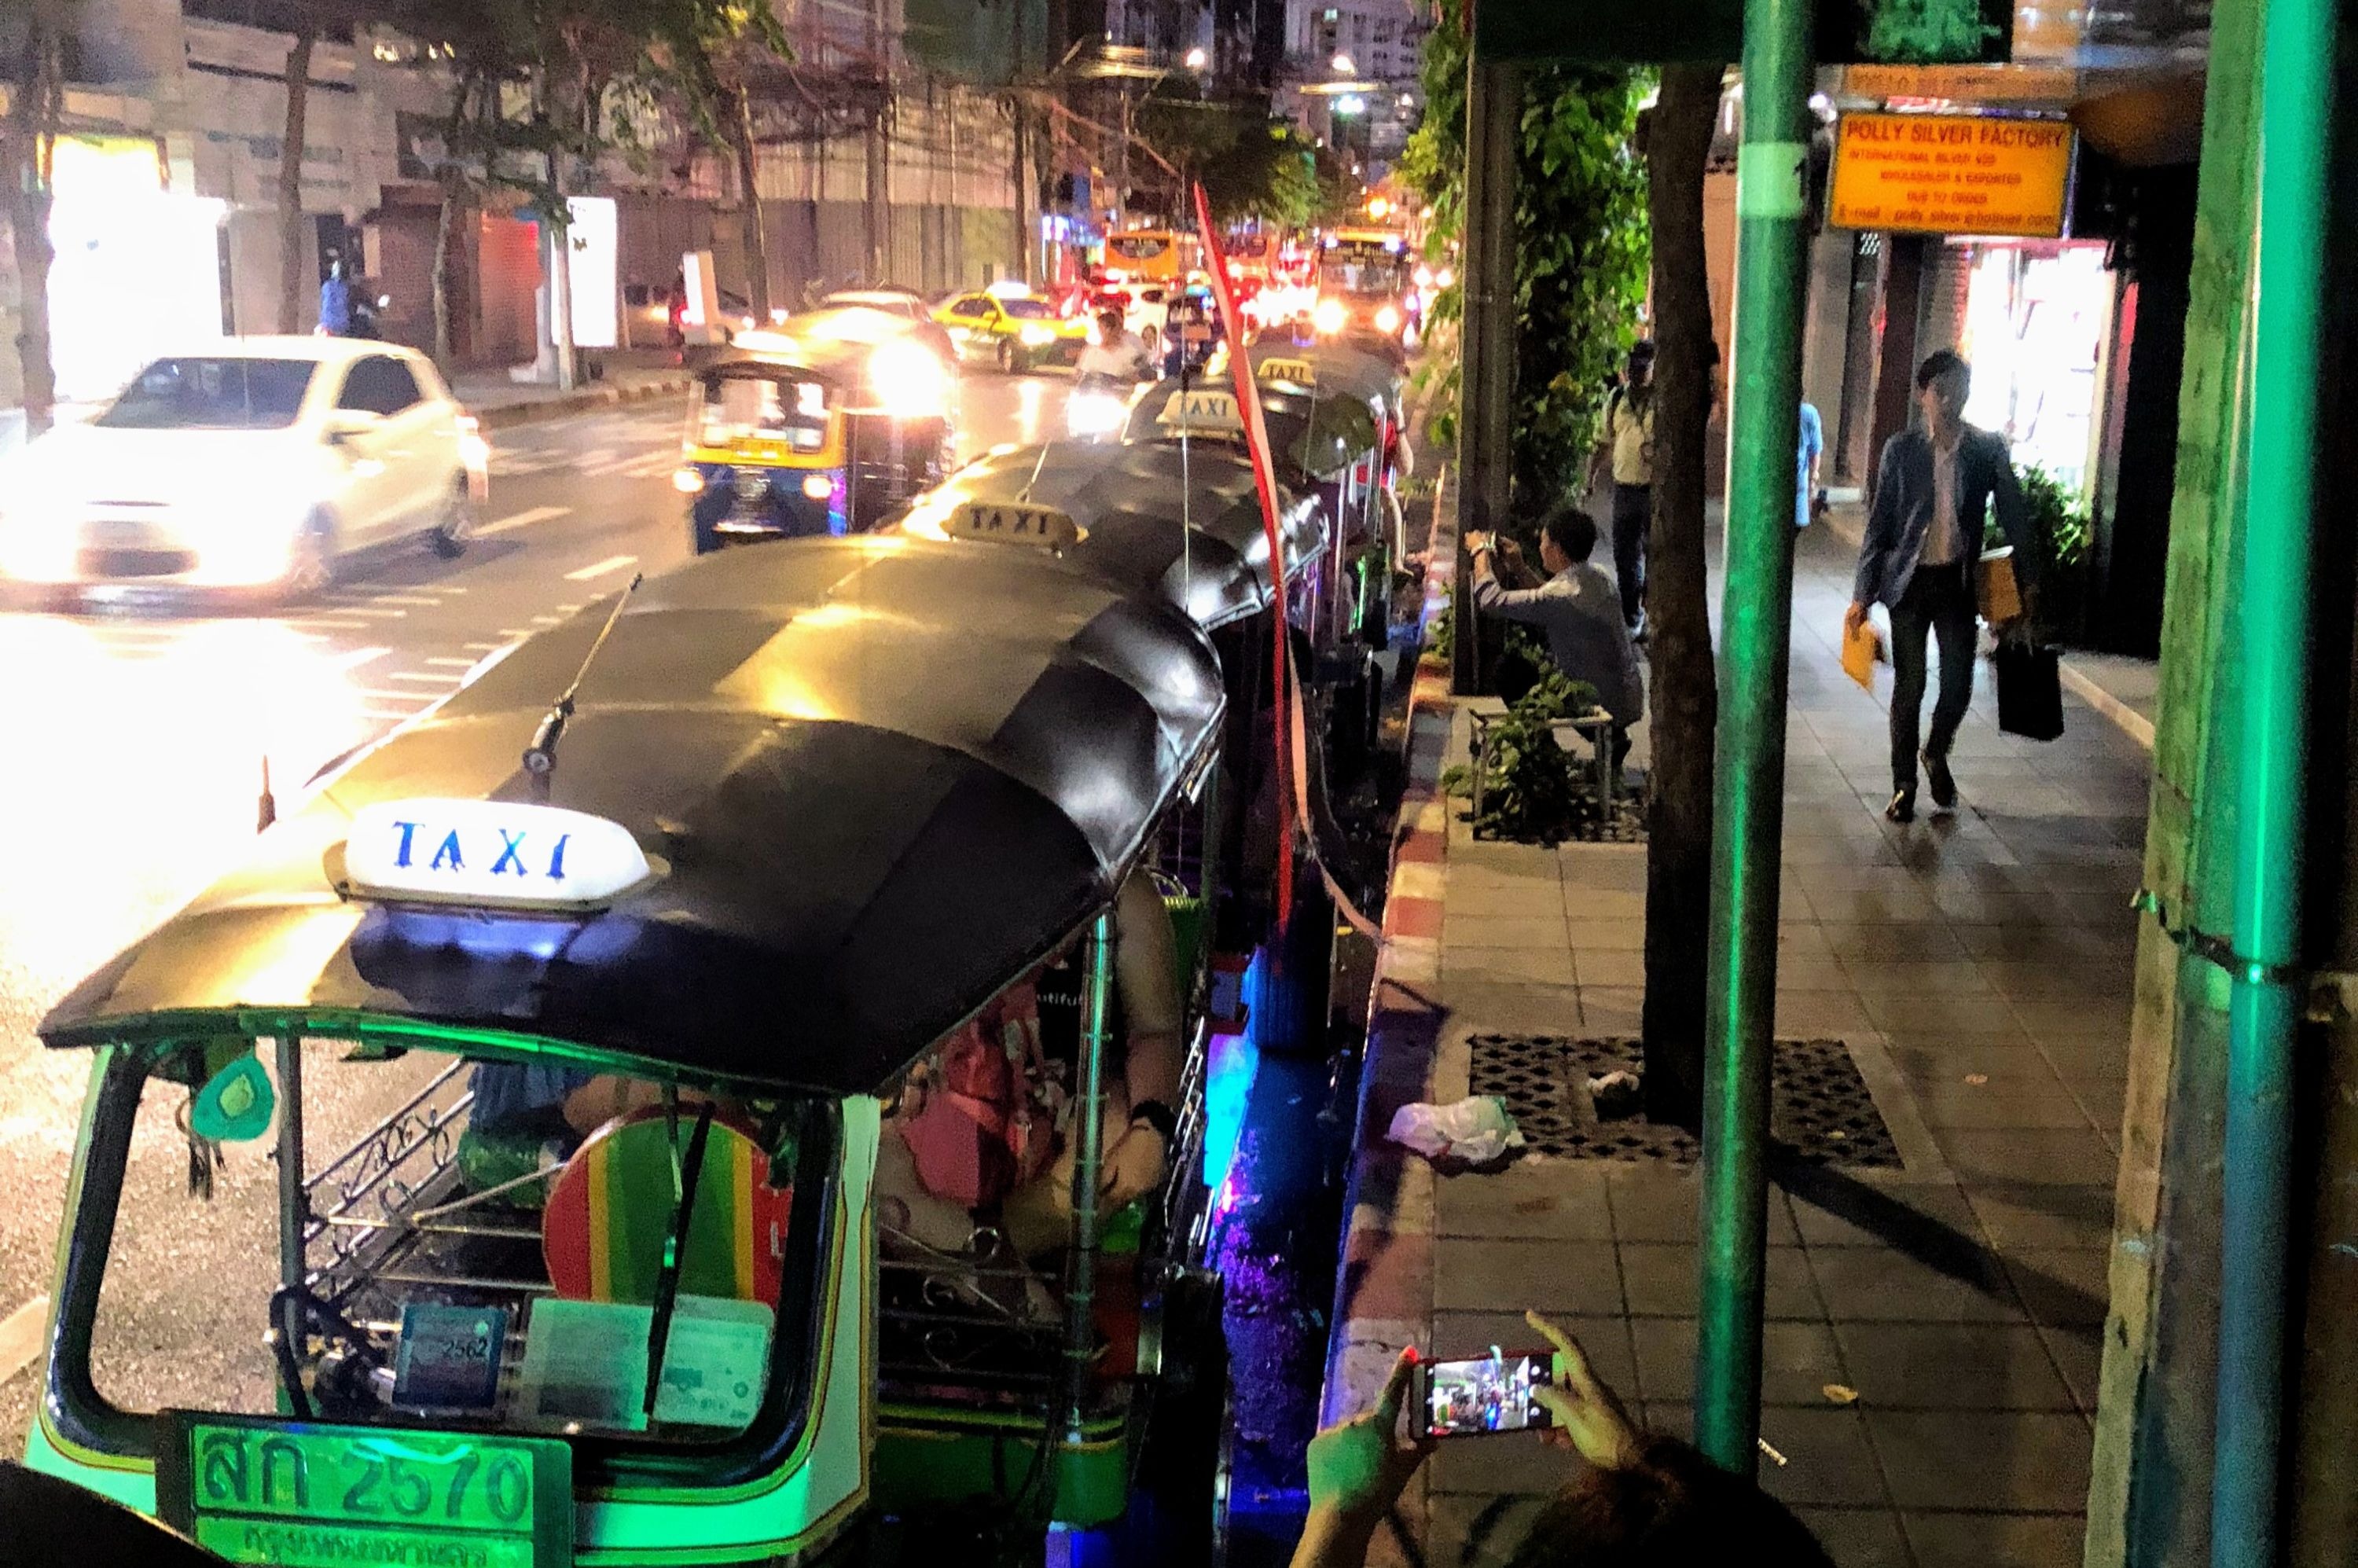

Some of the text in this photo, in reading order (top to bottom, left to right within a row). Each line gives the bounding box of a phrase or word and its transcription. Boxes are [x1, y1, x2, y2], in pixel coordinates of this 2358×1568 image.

[1847, 120, 2064, 149] POLLY SILVER FACTORY
[1268, 364, 1305, 380] TAXI
[970, 506, 1049, 535] TAXI
[391, 821, 571, 883] TAXI
[442, 1336, 488, 1358] 2562
[341, 1438, 530, 1523] 2570
